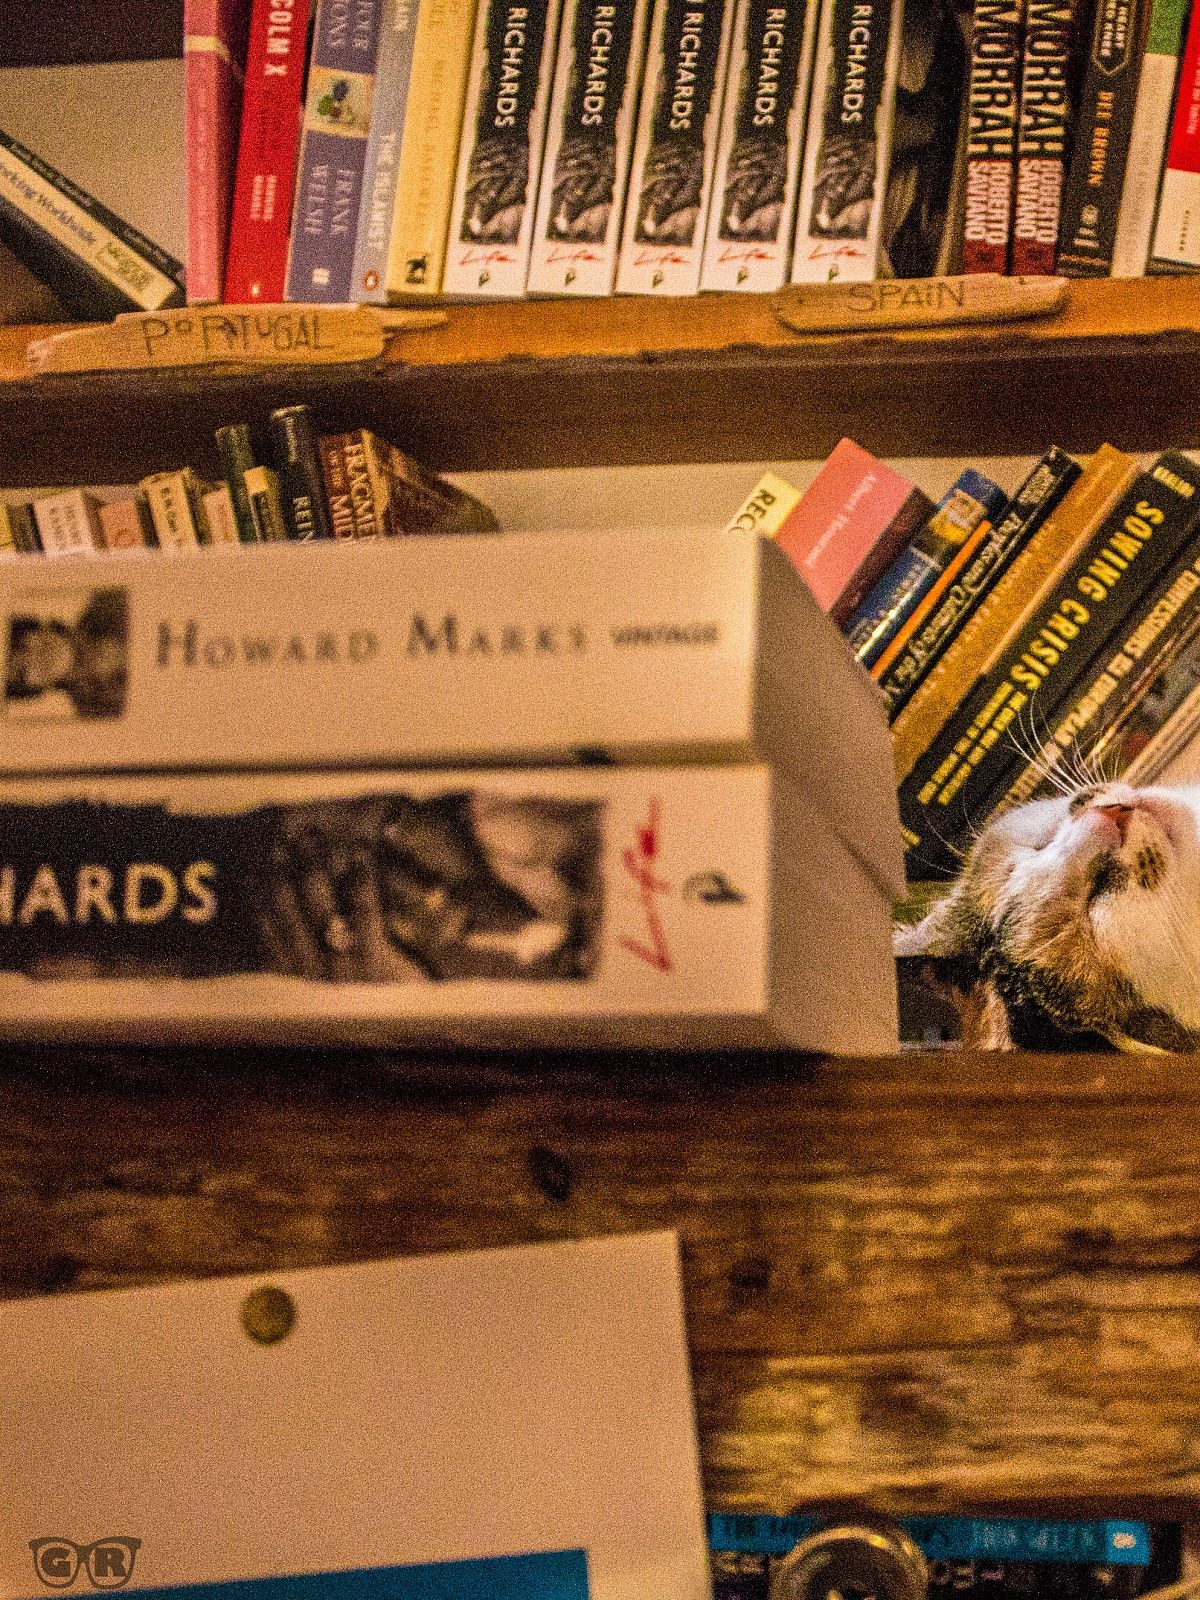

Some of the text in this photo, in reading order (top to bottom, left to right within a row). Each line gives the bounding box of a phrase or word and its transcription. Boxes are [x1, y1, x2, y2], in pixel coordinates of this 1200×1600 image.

[263, 62, 287, 77] X
[495, 7, 527, 127] RICHARDS
[581, 6, 617, 126] RICHARDS
[670, 12, 704, 130] RICHARDS
[752, 8, 786, 126] RICHARDS
[841, 5, 873, 123] RICHARDS
[1086, 90, 1114, 187] DEE BROWN
[302, 162, 330, 235] WELSH
[328, 166, 355, 237] FRANK
[962, 160, 990, 240] SAVIANO
[982, 160, 1013, 245] ROBERTO
[1013, 158, 1041, 239] SAVIANO
[1034, 159, 1063, 243] ROBERTO
[1077, 500, 1165, 602] SOWING
[155, 611, 720, 668] HOWARD MARKS VINTAGE
[1010, 597, 1091, 690] CRISIS
[1123, 569, 1200, 656] CONFESSIONS
[890, 654, 922, 688] the
[1053, 673, 1118, 745] EUROPEAN
